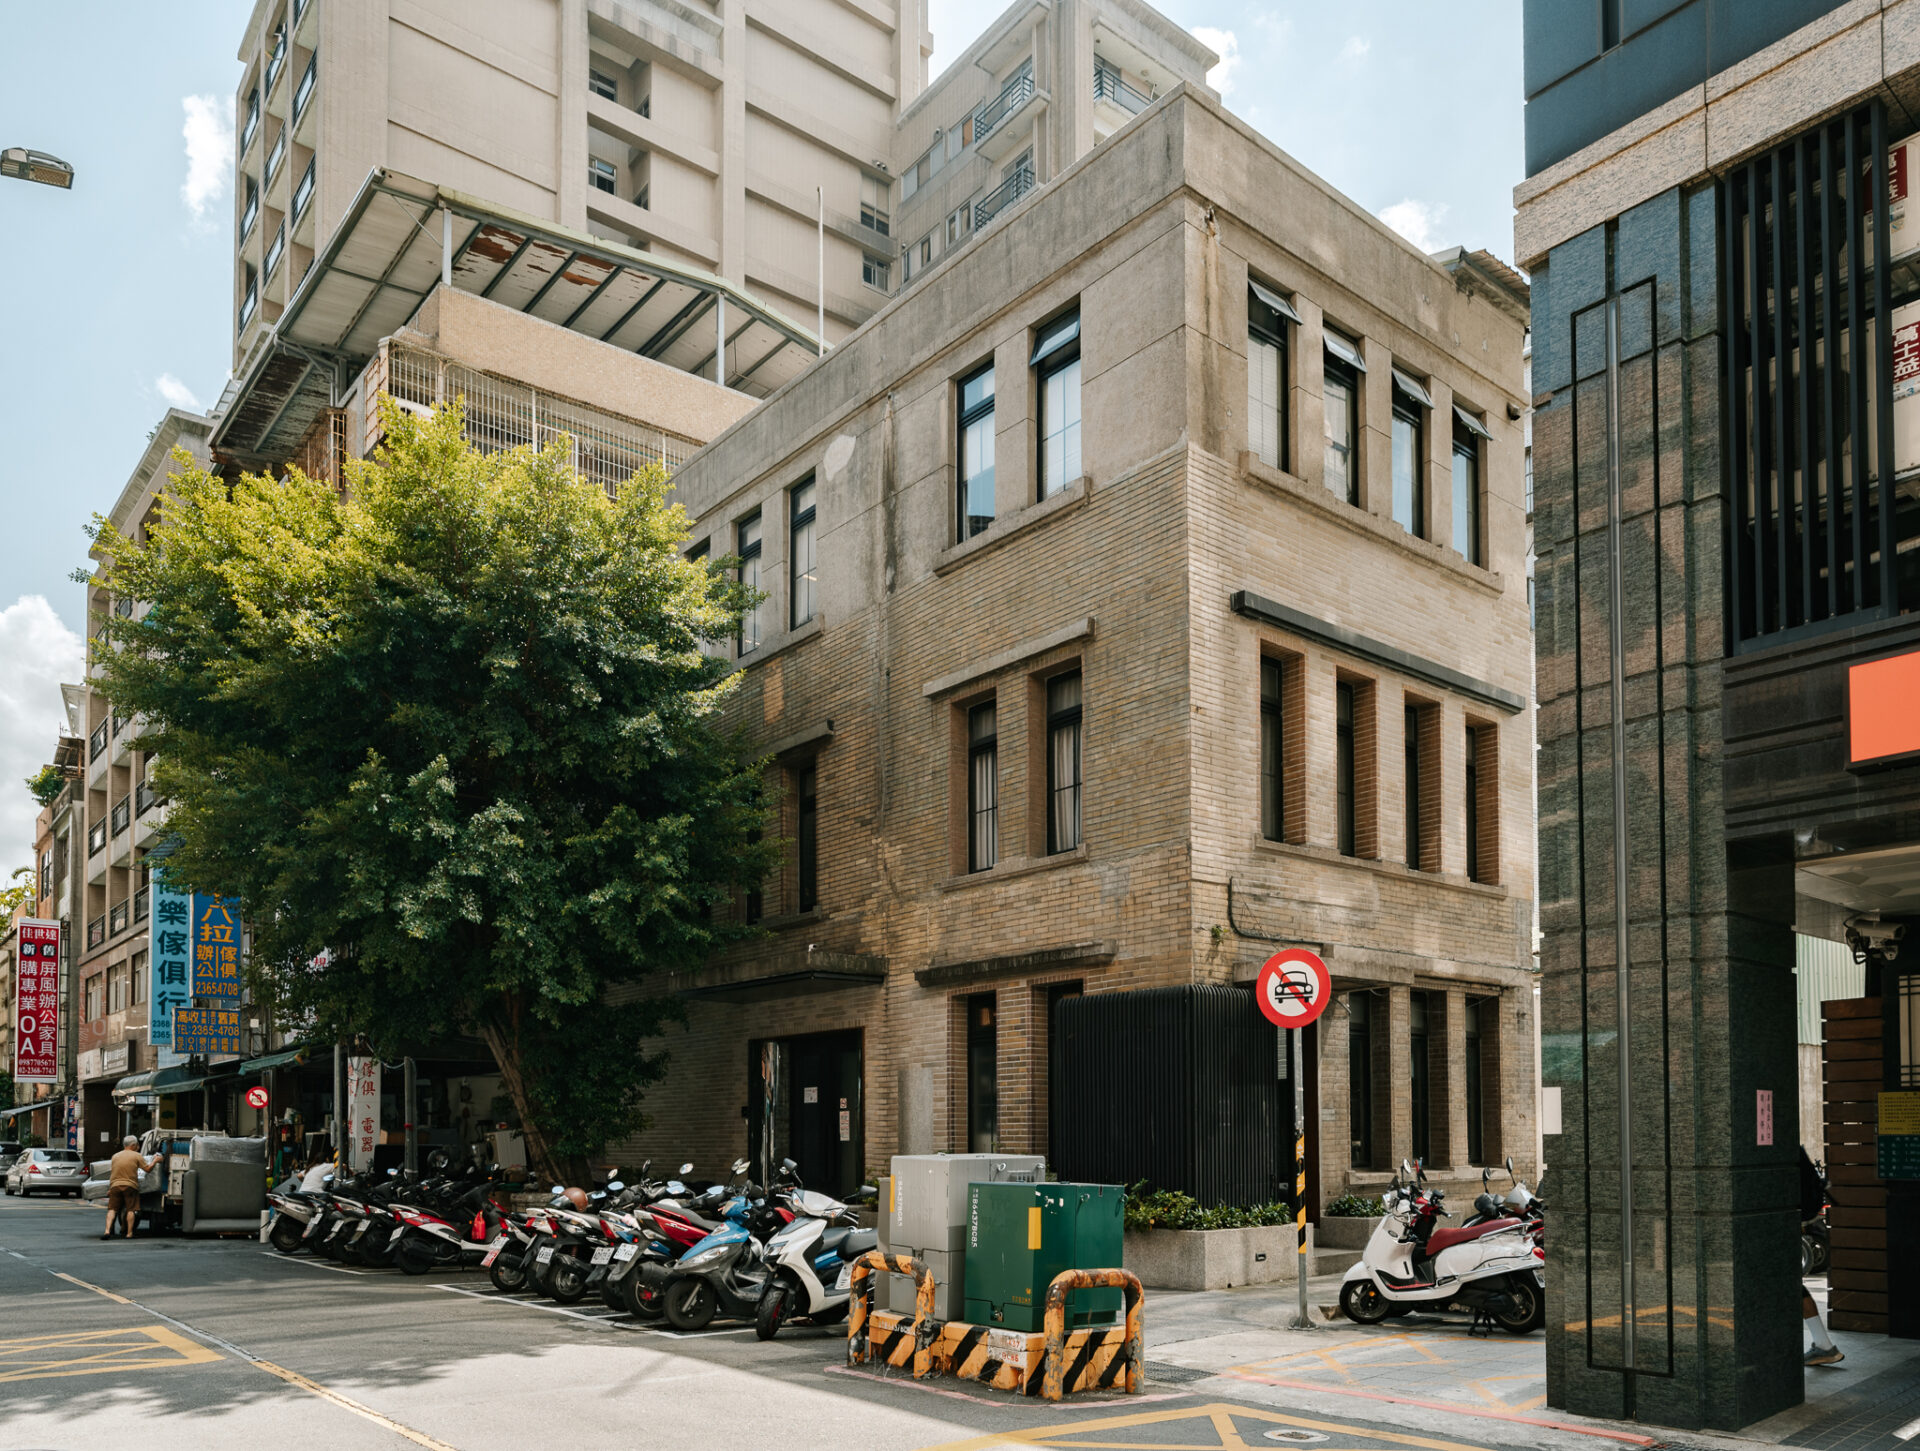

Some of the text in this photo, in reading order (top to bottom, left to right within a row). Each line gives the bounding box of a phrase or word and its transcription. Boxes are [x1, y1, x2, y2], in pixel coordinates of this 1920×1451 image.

[157, 866, 188, 1016] 樂傢俱行
[195, 981, 239, 996] 23654708
